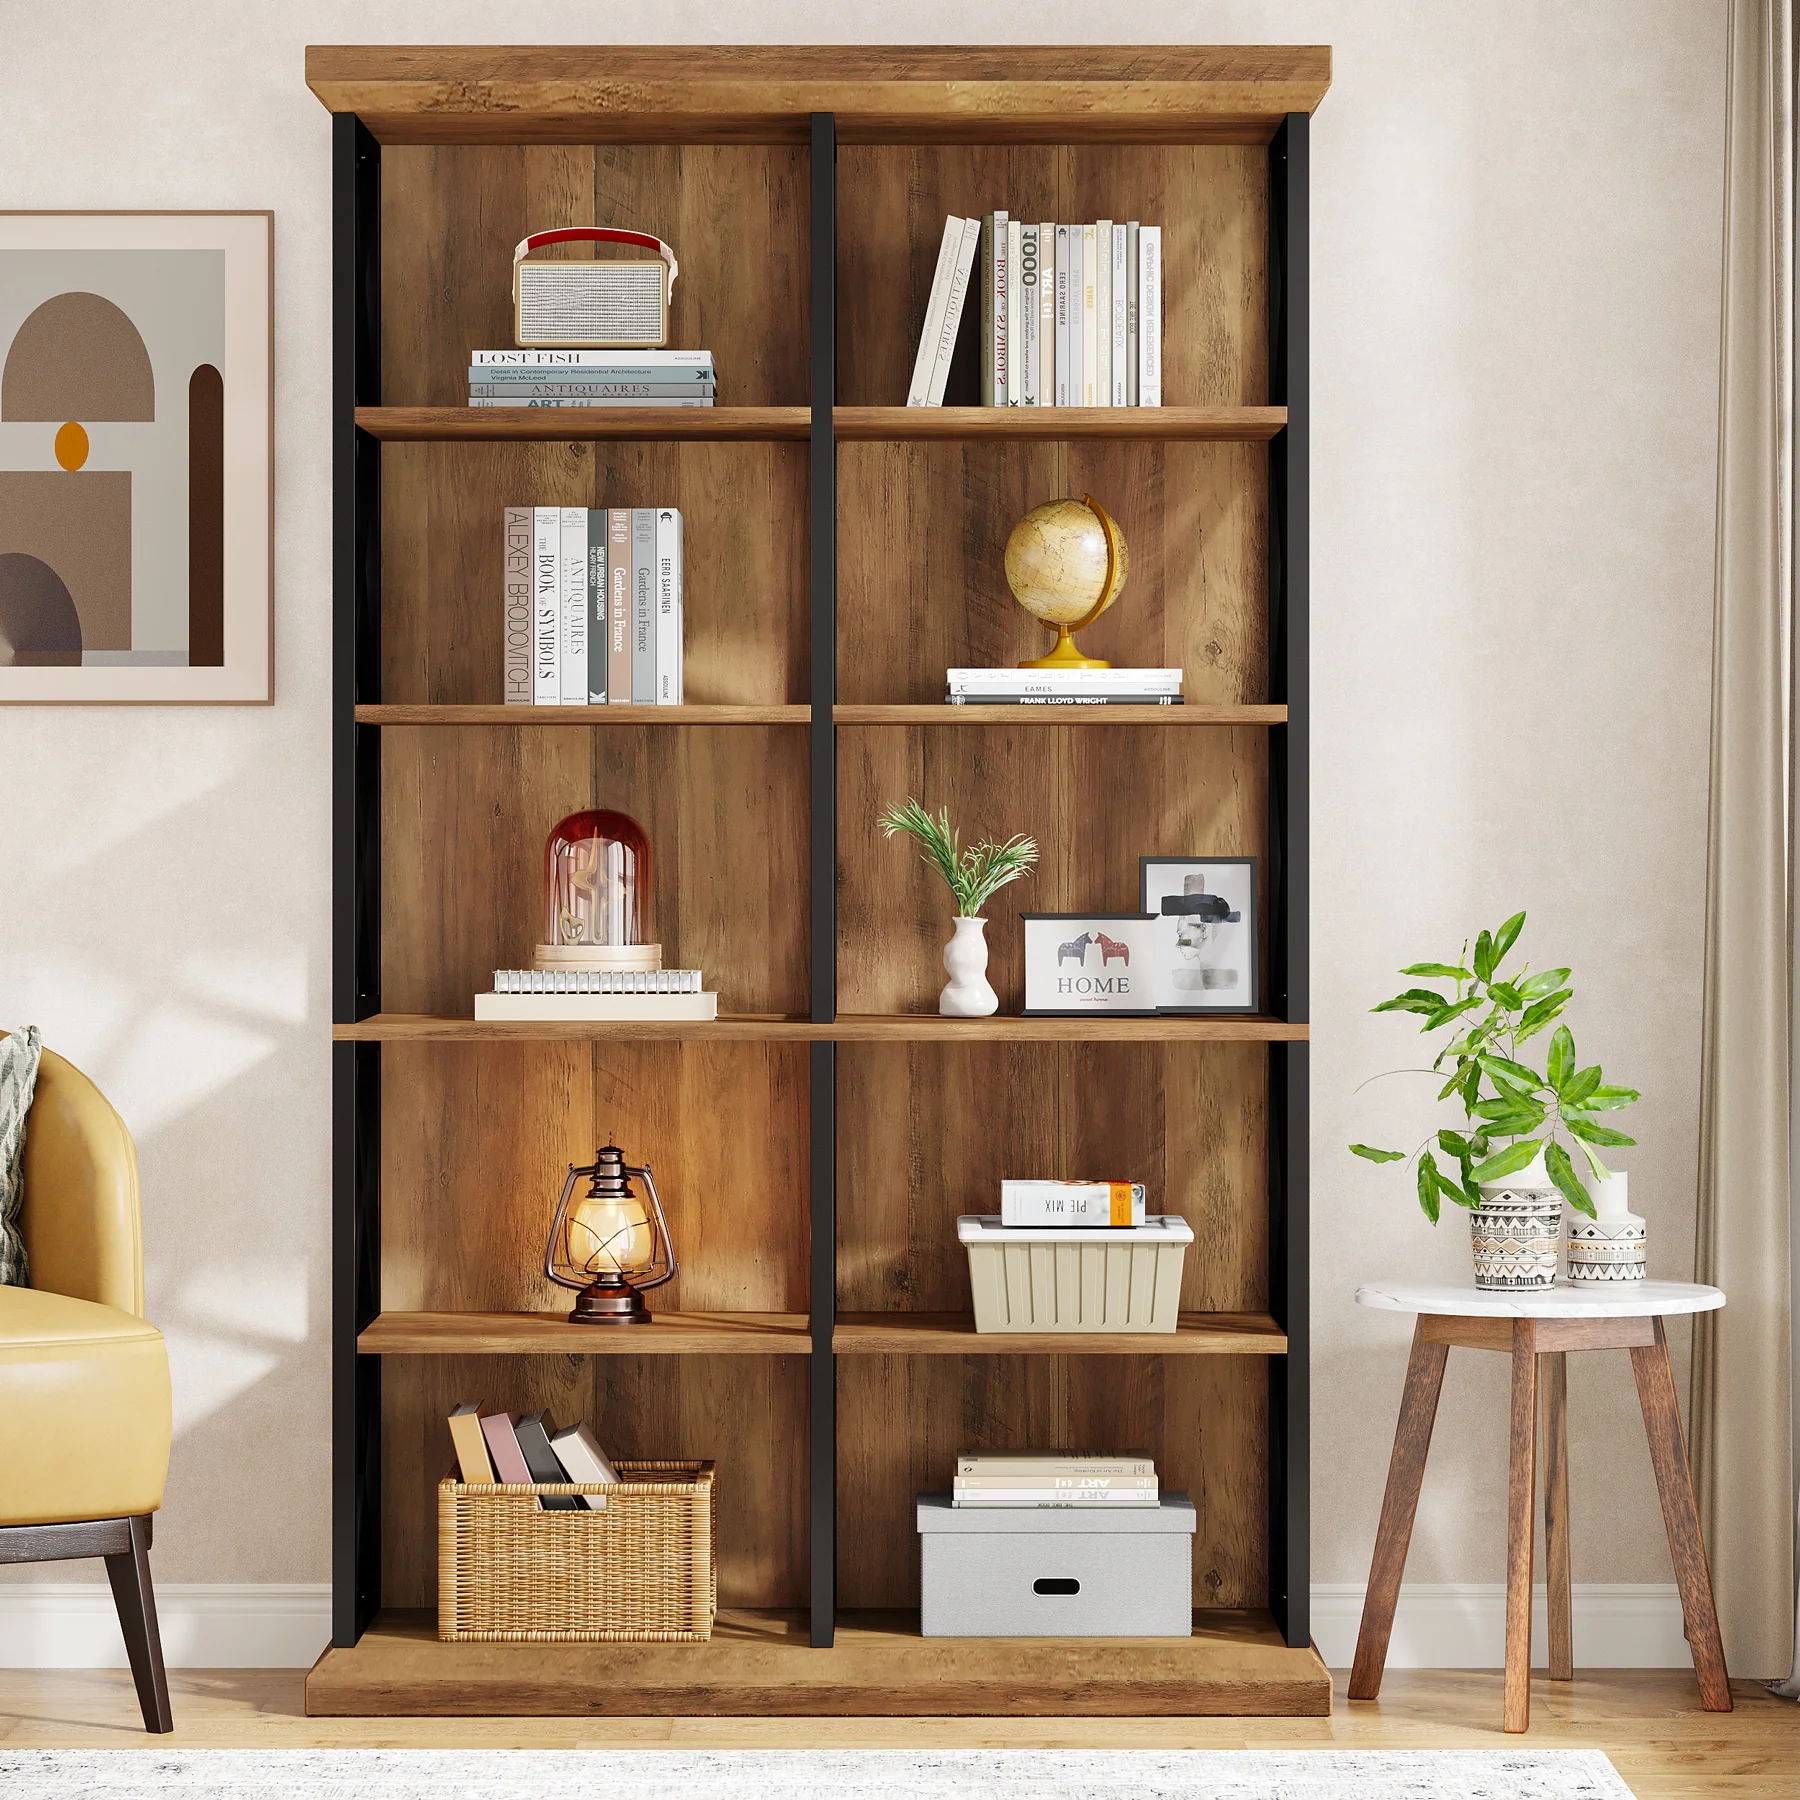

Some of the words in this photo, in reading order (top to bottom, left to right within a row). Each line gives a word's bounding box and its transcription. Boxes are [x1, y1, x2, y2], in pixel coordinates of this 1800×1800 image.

[480, 354, 530, 363] LOST
[537, 354, 580, 363] FISH
[532, 385, 650, 394] ANTIQUAIRES
[508, 512, 529, 578] ALEXEY
[538, 554, 555, 593] BOOK
[662, 558, 670, 576] EERO
[614, 568, 626, 607] Gardens
[638, 568, 650, 607] Gardens
[662, 579, 670, 614] SAARINEN
[539, 597, 546, 606] OF
[568, 557, 584, 655] ANTIQUAIRES
[614, 609, 626, 618] in
[638, 609, 650, 618] in
[508, 584, 529, 693] BRODOVITCH
[538, 609, 555, 679] SYMBOLS
[614, 620, 626, 652] France
[638, 620, 650, 652] France
[1057, 977, 1130, 993] HOME
[1045, 1200, 1063, 1212] MIX
[1070, 1200, 1086, 1212] PIE
[1078, 1479, 1110, 1488] ART
[1078, 1491, 1110, 1499] ART
